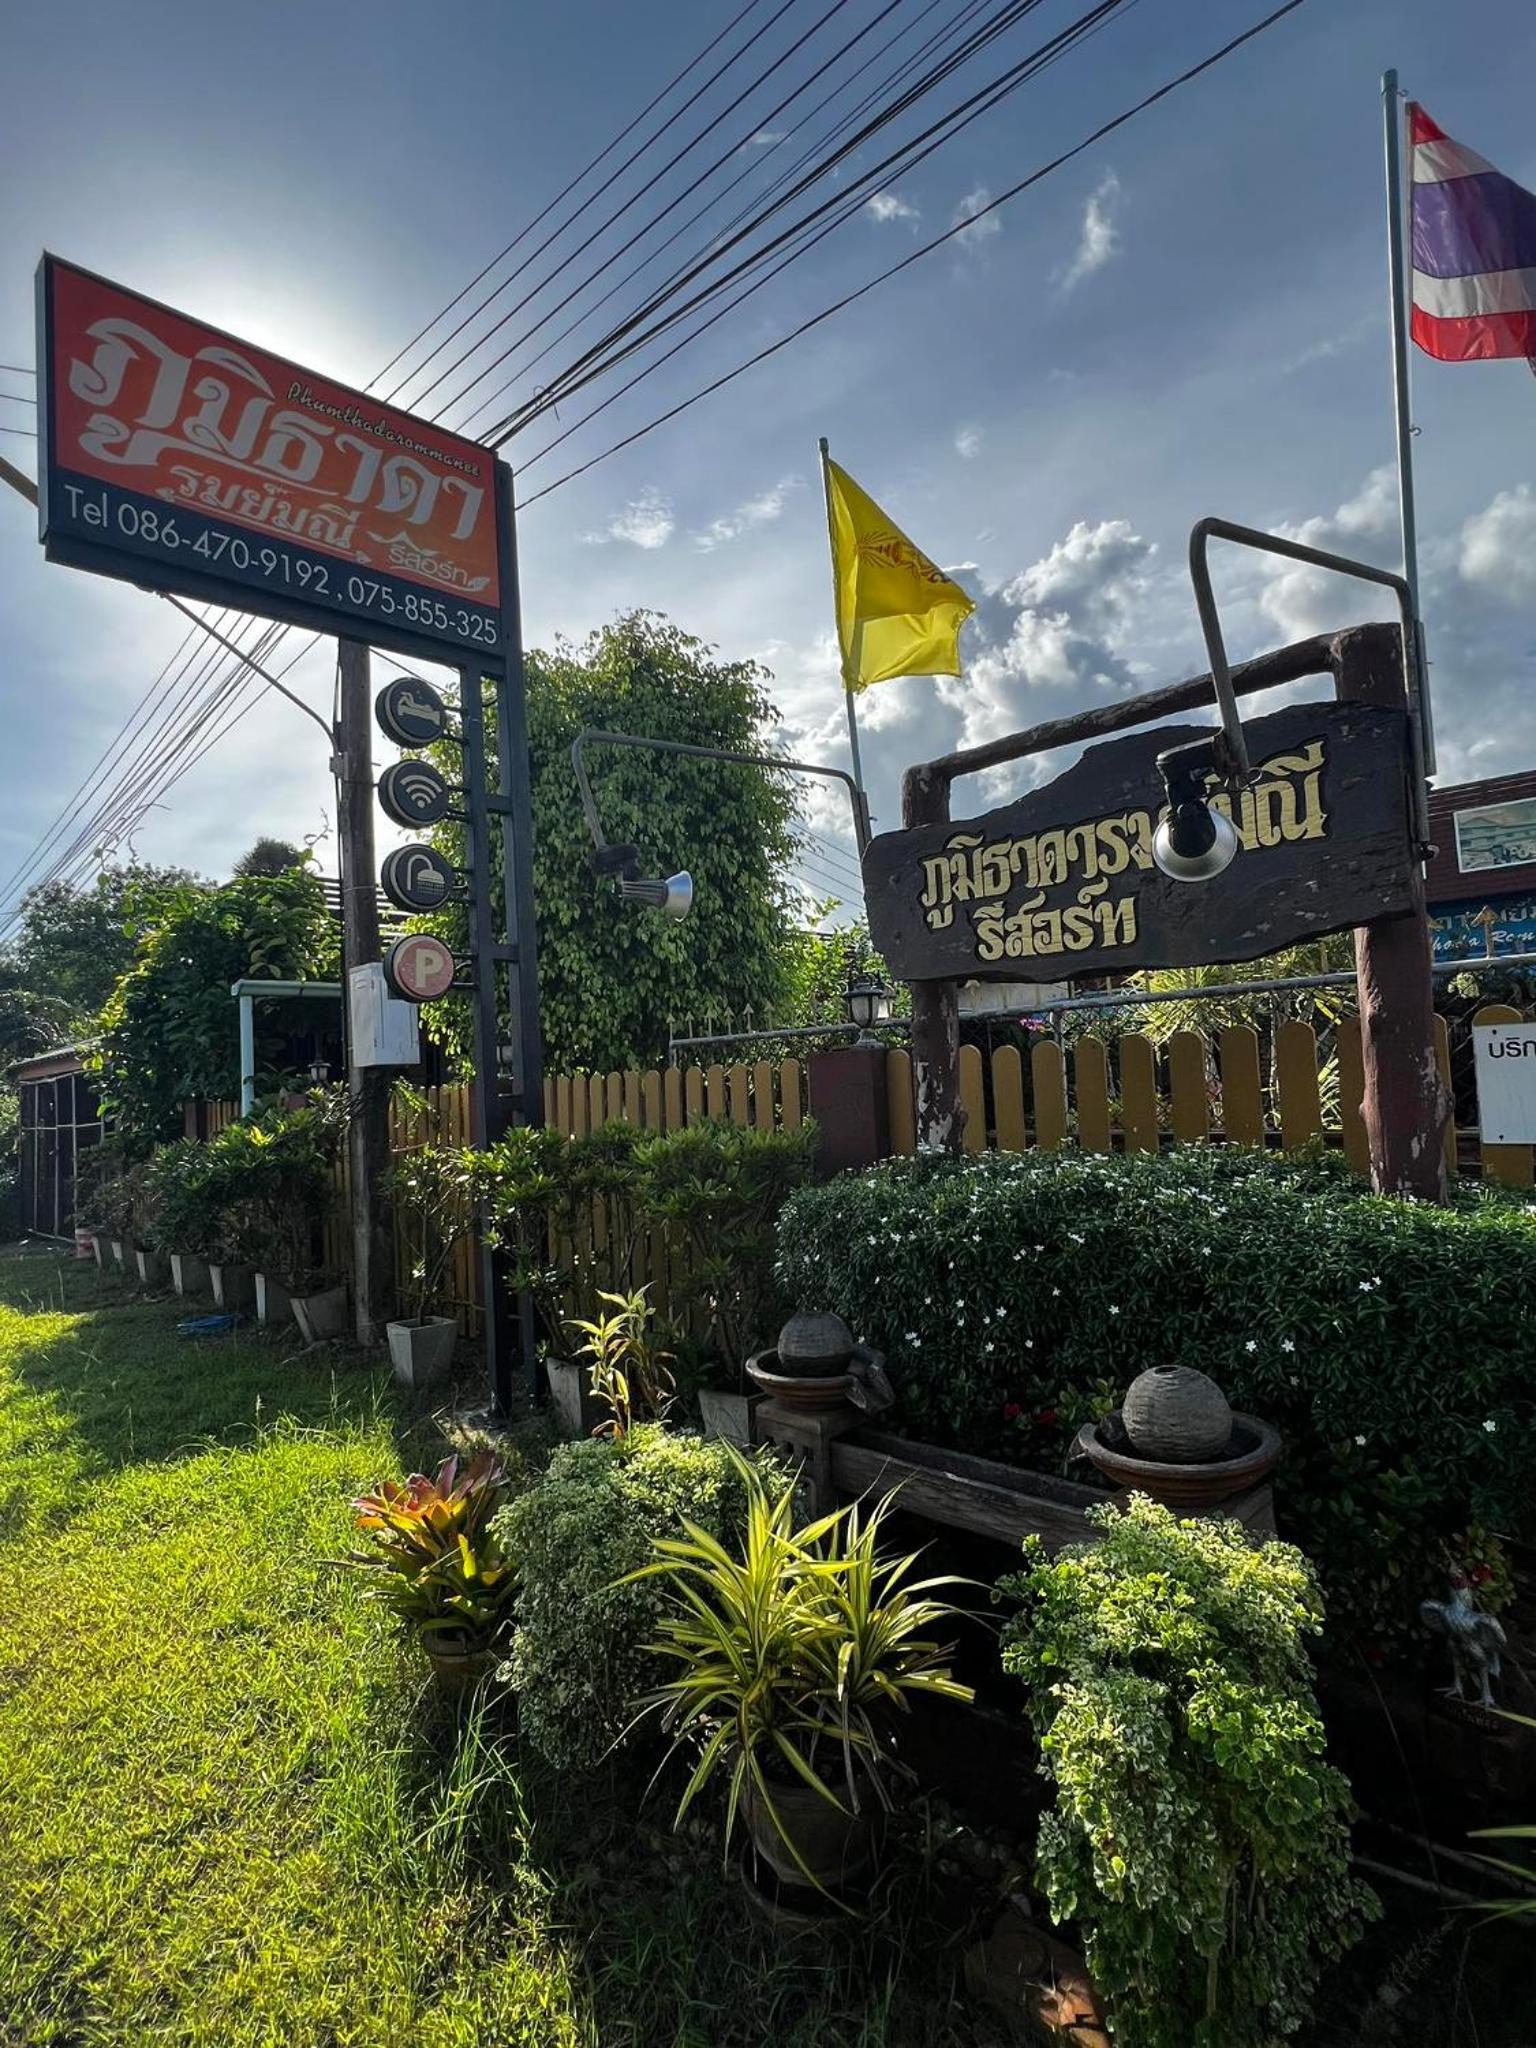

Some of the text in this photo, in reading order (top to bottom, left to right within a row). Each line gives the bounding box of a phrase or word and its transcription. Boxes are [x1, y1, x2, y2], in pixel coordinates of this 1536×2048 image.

[68, 317, 485, 541] ภูมิธาดา
[64, 484, 108, 528] Tel
[118, 503, 330, 595] 086-470-9192
[348, 575, 498, 644] 075-855-325
[921, 740, 1329, 930] ภูมิธาดารมณี
[414, 948, 445, 989] P
